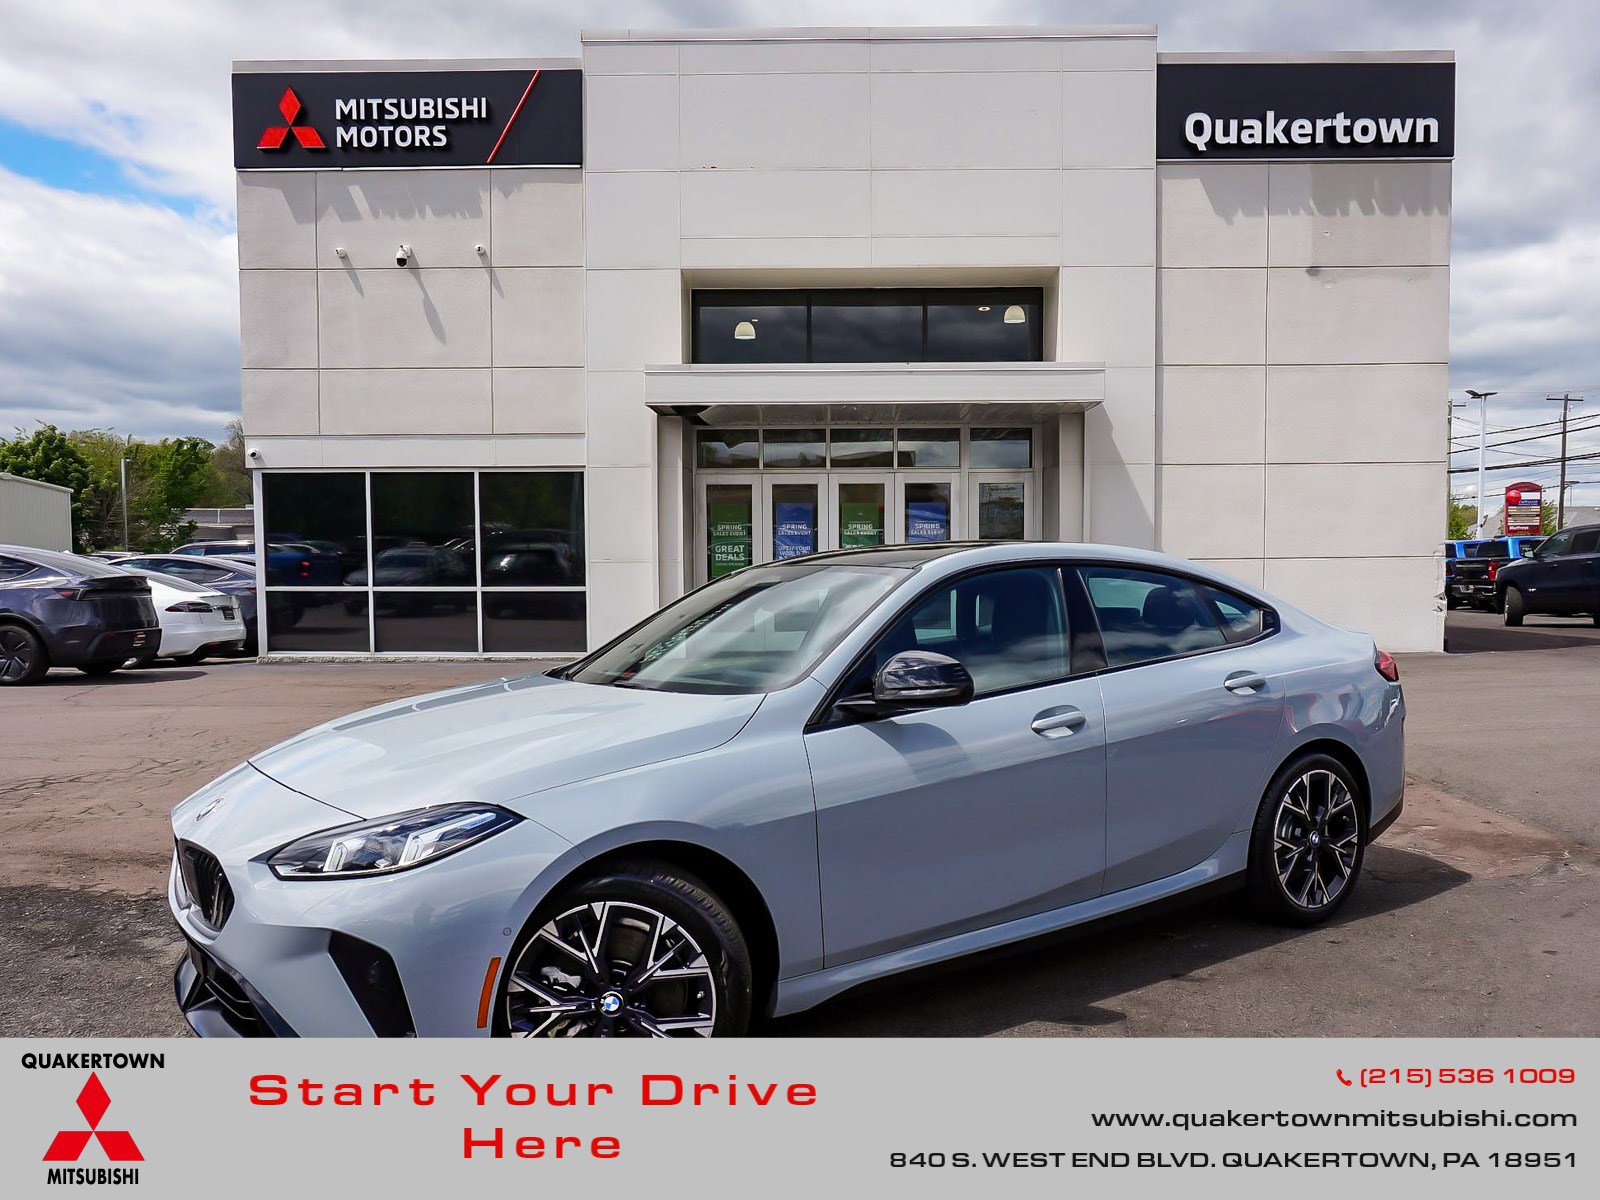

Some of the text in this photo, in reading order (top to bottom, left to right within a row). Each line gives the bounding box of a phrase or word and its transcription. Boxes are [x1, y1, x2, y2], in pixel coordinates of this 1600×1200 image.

[335, 97, 487, 120] MITSUBISHI
[336, 125, 447, 148] MOTORS
[1185, 110, 1439, 151] Quakertown
[715, 545, 745, 553] GREAT
[715, 553, 745, 561] DEALS
